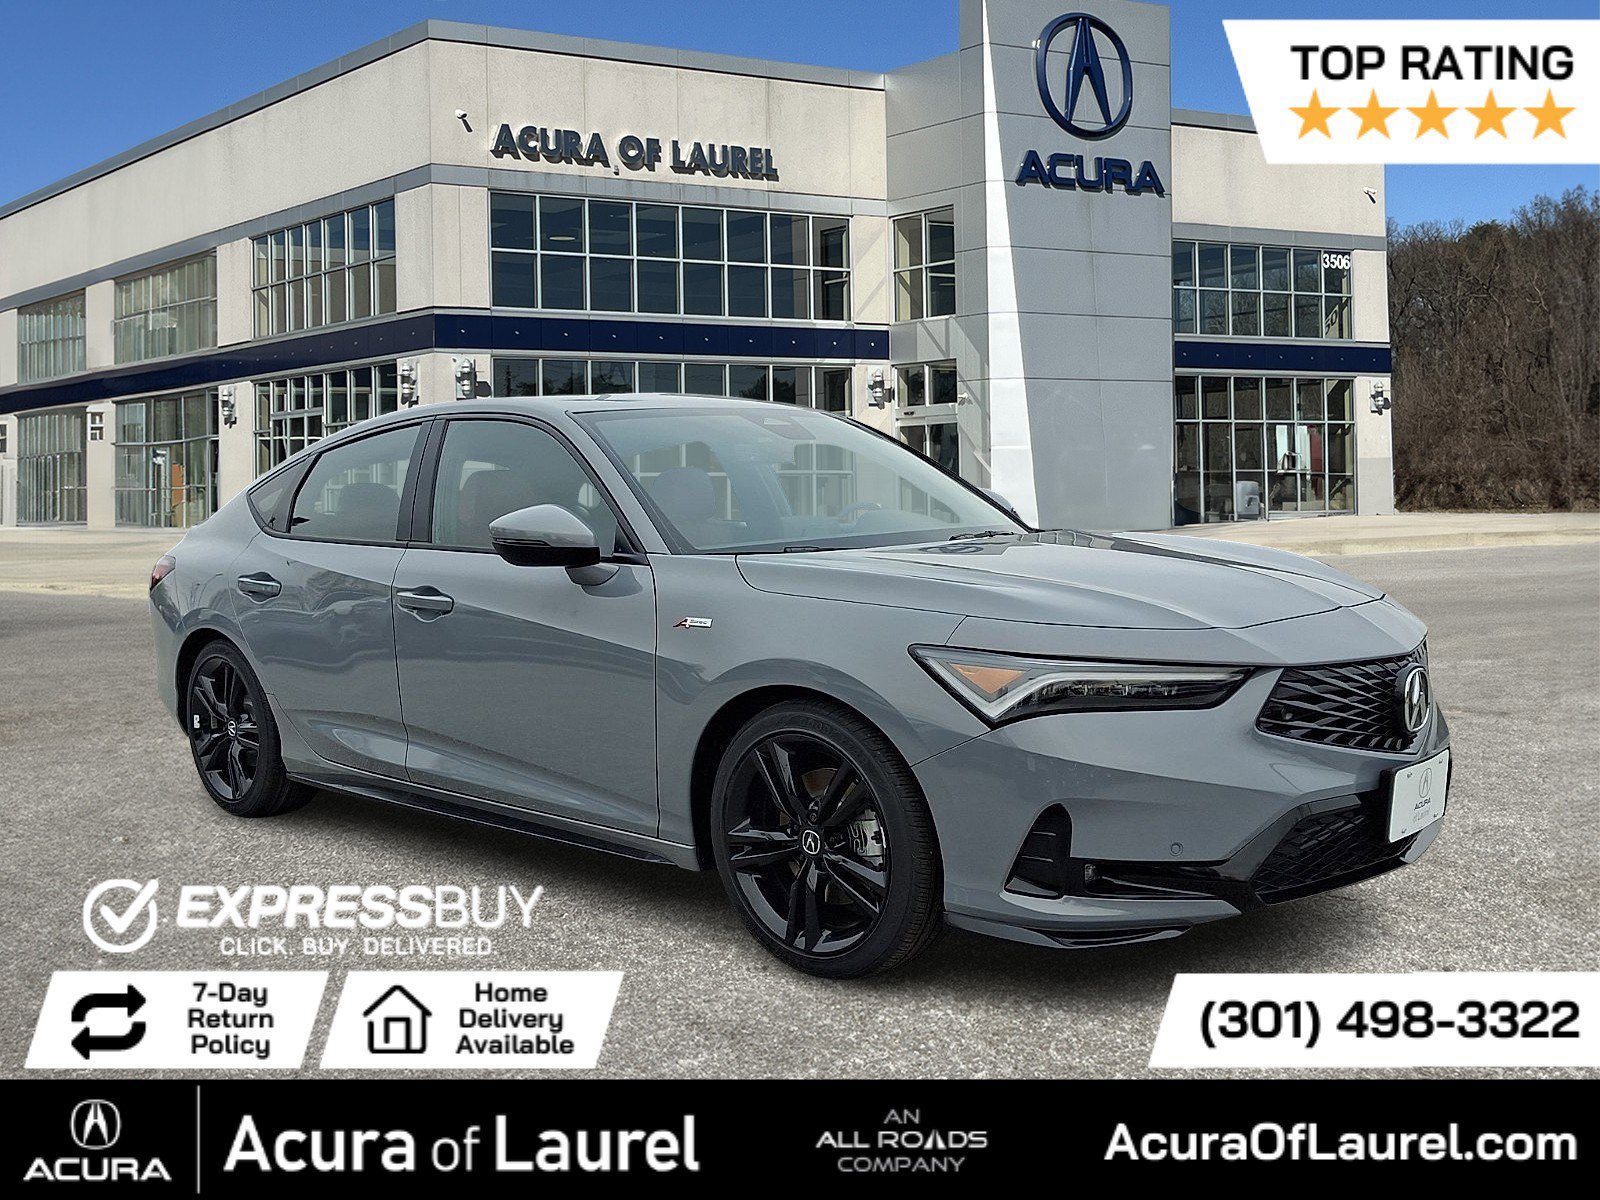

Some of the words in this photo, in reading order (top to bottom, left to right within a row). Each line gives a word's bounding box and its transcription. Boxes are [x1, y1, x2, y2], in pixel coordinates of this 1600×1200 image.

[491, 123, 611, 168] ACURA
[617, 135, 662, 171] OF
[670, 140, 779, 182] LAUREL
[1015, 150, 1165, 198] ACURA
[1322, 253, 1351, 270] 3506
